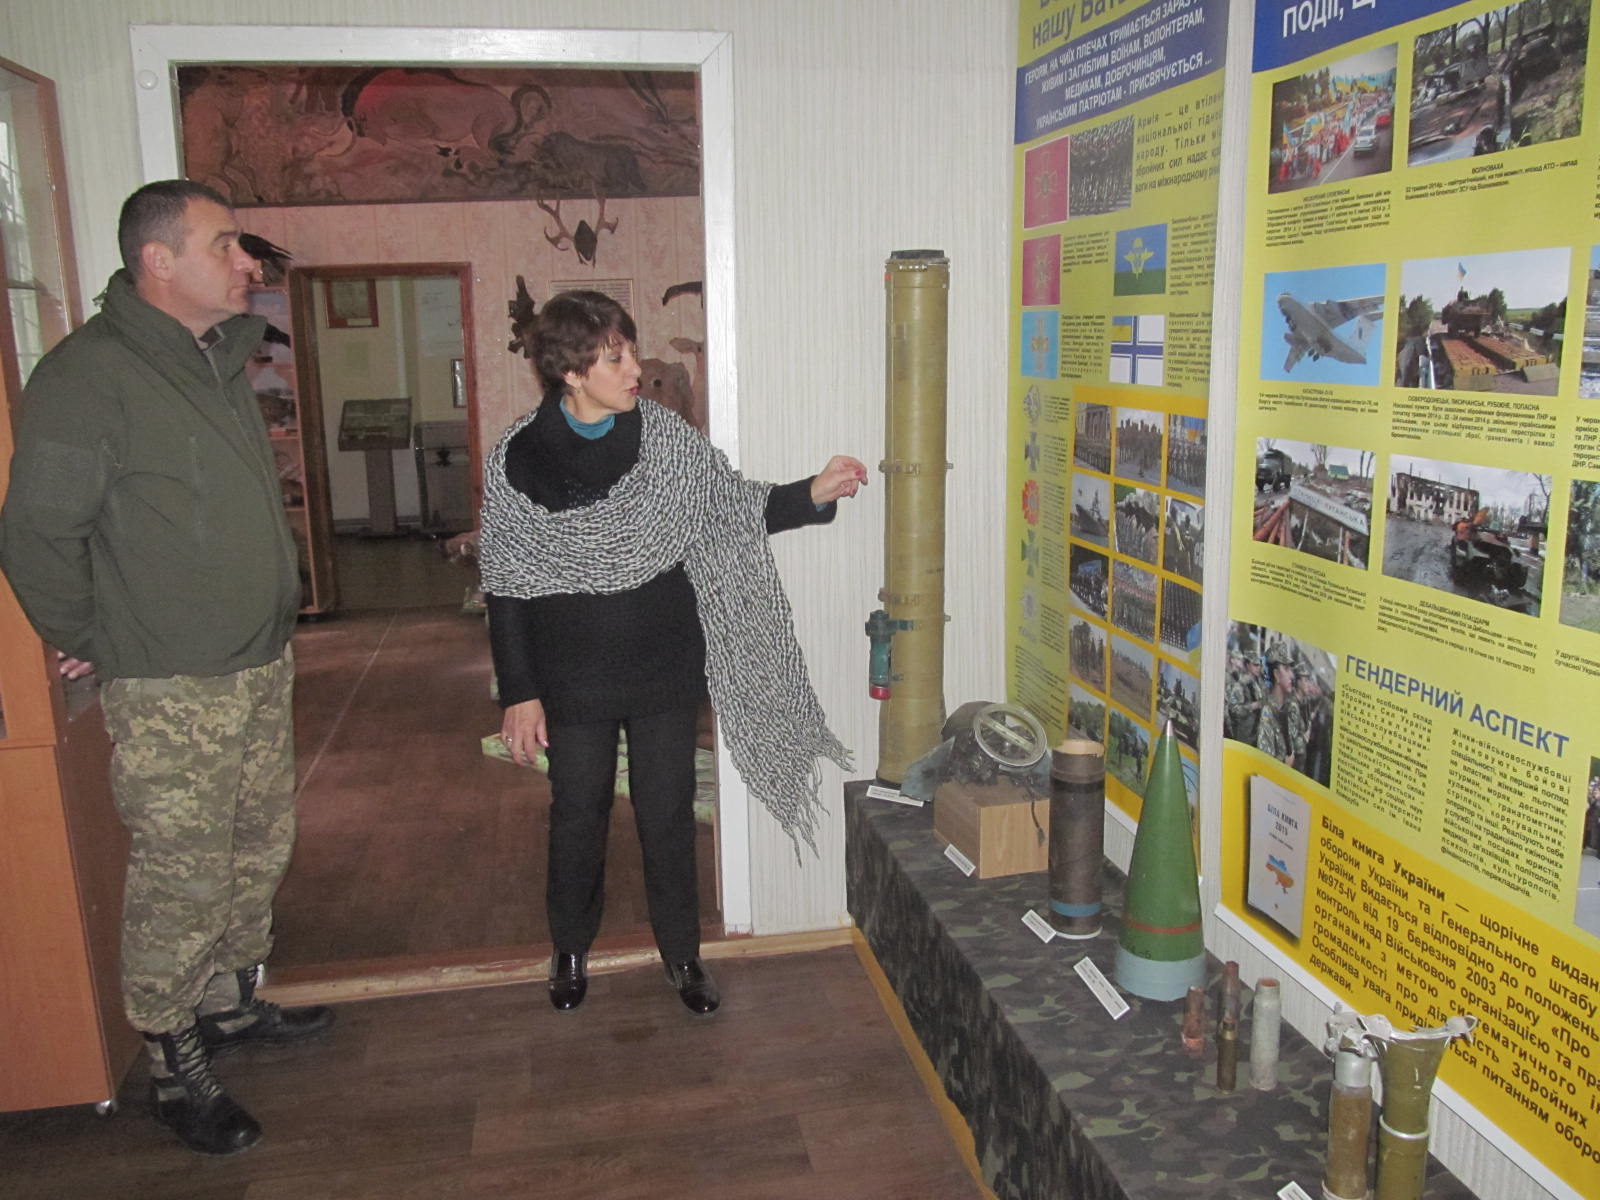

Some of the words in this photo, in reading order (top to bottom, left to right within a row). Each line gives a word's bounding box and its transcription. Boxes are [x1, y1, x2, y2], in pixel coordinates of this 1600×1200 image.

[1032, 2, 1076, 50] нашу
[1041, 72, 1064, 95] ЖИВИМ
[1068, 53, 1109, 82] ЗАГИБЛИМ
[1110, 38, 1142, 65] ВОЇНАМ,
[1143, 7, 1205, 49] ВОЛОНТЕРАМ,
[1049, 58, 1059, 73] НА
[1059, 48, 1075, 67] ЧИЇХ
[1076, 34, 1108, 59] ПЛЕЧАХ
[1109, 6, 1161, 46] ТРИМАЄТЬСЯ
[1065, 75, 1103, 101] МЕДИКАМ,
[1104, 46, 1166, 88] ДОБРОЧИНЦЯМ,
[1079, 86, 1122, 113] ПАТРІОТАМ
[1129, 51, 1203, 95] ПРИСВЯЧУЄТЬСЯ
[1179, 104, 1189, 117] це
[1169, 157, 1183, 169] сил
[1175, 134, 1206, 150] Тільки
[1346, 654, 1464, 718] ГЕНДЕРНИЙ
[1469, 703, 1570, 758] АСПЕКТ
[1412, 712, 1433, 727] склад
[1451, 739, 1519, 773] опановують
[1526, 771, 1571, 795] бойові
[1451, 749, 1497, 776] спеціальності,
[1499, 772, 1508, 780] на
[1509, 776, 1539, 792] перший
[1541, 788, 1569, 806] погляд
[1452, 727, 1571, 784] Жінки-військовослужбовці
[1463, 765, 1493, 784] властиві
[1446, 798, 1475, 817] оператор
[1476, 813, 1484, 821] та
[1502, 825, 1545, 850] Реалізують
[1546, 846, 1565, 859] себе
[1487, 787, 1513, 805] моряк,
[1519, 802, 1568, 829] десантник,
[1490, 810, 1566, 850] корегувальник,
[1498, 803, 1567, 840] гранатометник,
[1441, 836, 1487, 867] психологів,
[1493, 864, 1560, 903] культурологів,
[1483, 828, 1524, 851] традиційно
[1524, 846, 1563, 869] «жіночих»
[1487, 839, 1520, 860] посадах
[1526, 858, 1562, 882] юристів,
[1321, 815, 1344, 839] Біла
[1352, 837, 1385, 865] книга
[1393, 859, 1446, 901] України
[1455, 903, 1470, 913] —
[1480, 913, 1540, 956] щорічне
[1551, 954, 1600, 994] видан
[1481, 868, 1533, 898] перекладачів.
[1515, 864, 1561, 892] політологів,
[1314, 904, 1371, 950] органами»
[1380, 951, 1387, 963] з
[1396, 962, 1439, 998] метою
[1319, 850, 1357, 886] України.
[1360, 879, 1418, 926] Видається
[1423, 922, 1495, 974] відповідно
[1499, 970, 1519, 989] до
[1525, 984, 1600, 1042] положень
[1320, 837, 1361, 871] оборони
[1368, 864, 1409, 901] України
[1417, 899, 1431, 915] та
[1441, 910, 1537, 979] Генерального
[1549, 977, 1598, 1019] штабу
[1309, 953, 1354, 994] держави.
[1316, 887, 1361, 925] контроль
[1363, 920, 1382, 943] над
[1385, 933, 1457, 990] Військовою
[1460, 986, 1550, 1055] організацією
[1555, 1049, 1572, 1070] та
[1317, 868, 1357, 903] №975-IV
[1362, 901, 1379, 922] від
[1387, 915, 1399, 932] 19
[1407, 929, 1457, 971] березня
[1466, 966, 1497, 996] 2003
[1507, 995, 1541, 1027] року
[1551, 1026, 1591, 1059] «Про
[1311, 934, 1360, 979] Особлива
[1362, 975, 1392, 1004] увага
[1482, 1065, 1549, 1124] питанням
[1313, 920, 1388, 982] громадськості
[1395, 981, 1419, 1004] про
[1512, 1060, 1588, 1129] Збройних
